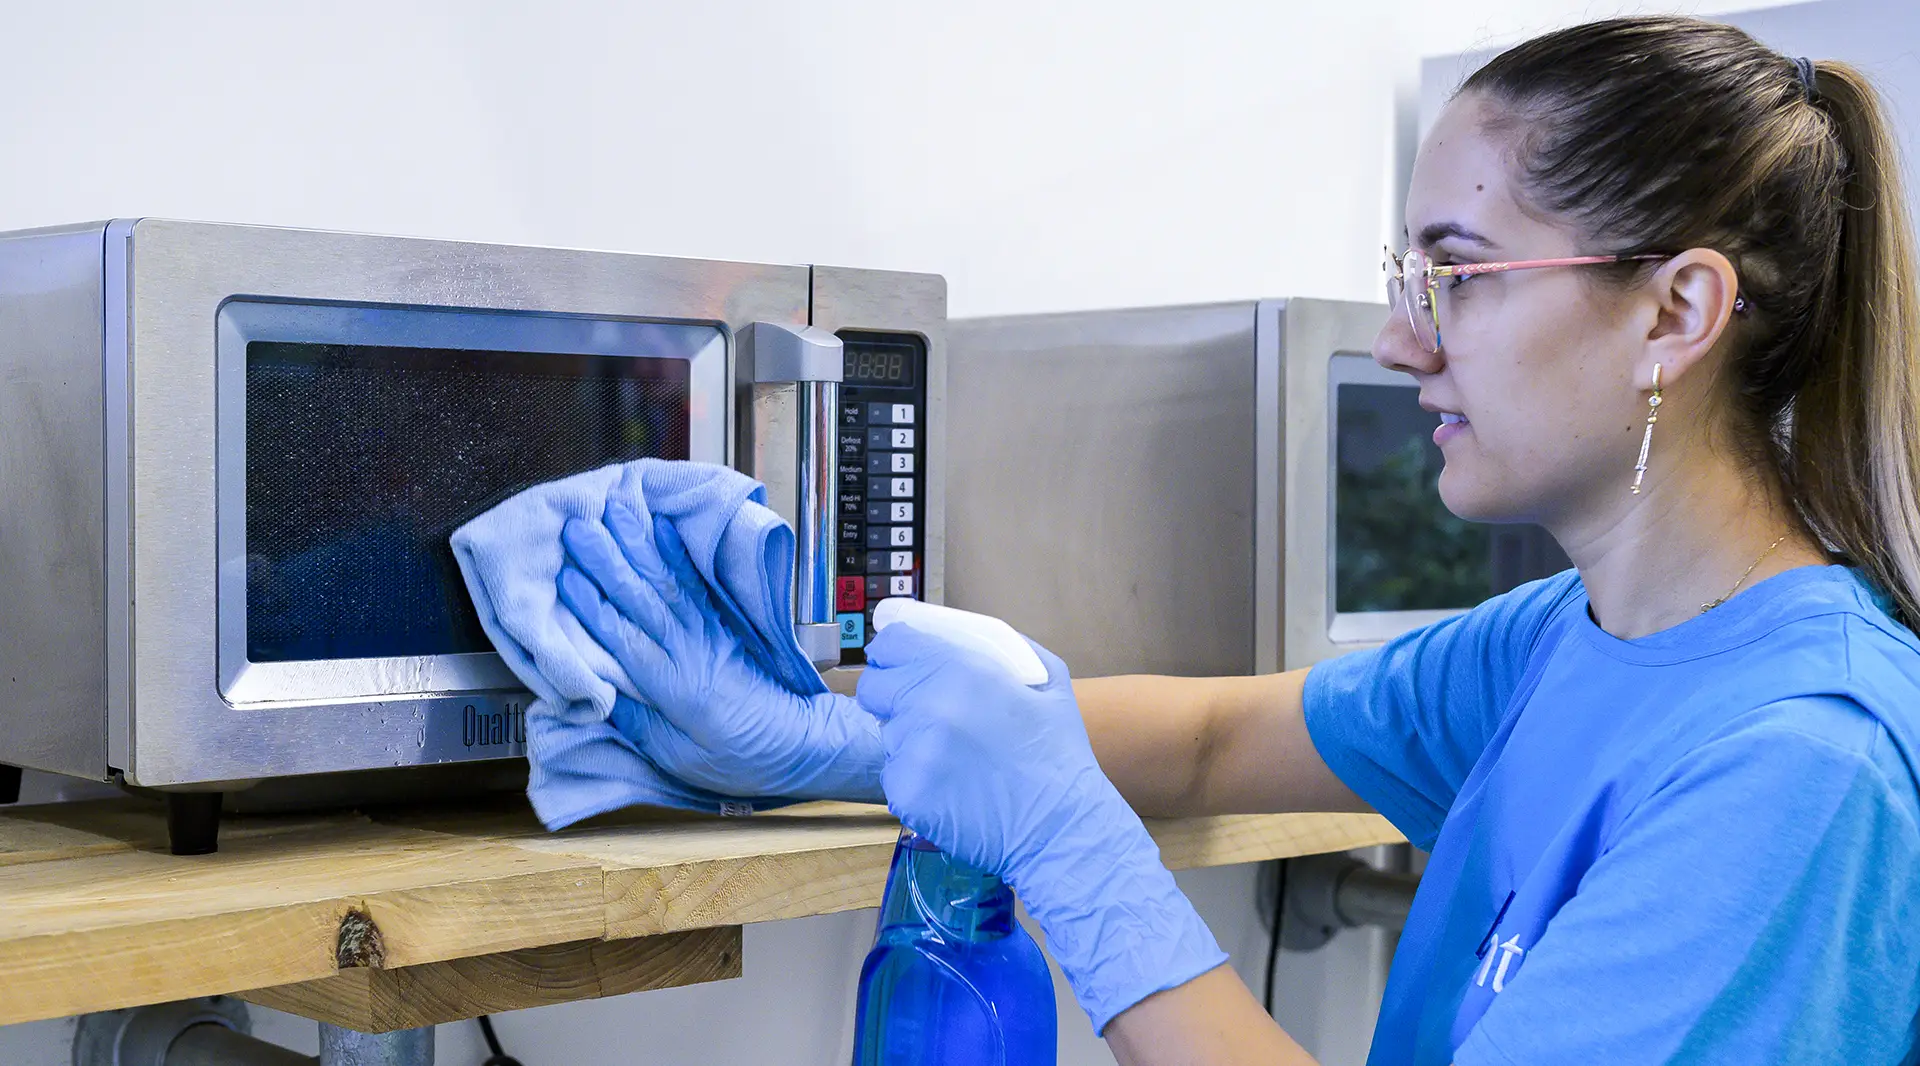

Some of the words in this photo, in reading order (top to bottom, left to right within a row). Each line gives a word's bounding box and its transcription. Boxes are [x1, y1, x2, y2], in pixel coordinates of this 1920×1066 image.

[844, 407, 859, 416] Hold
[901, 408, 906, 419] 1
[846, 416, 856, 424] 0%
[840, 436, 862, 445] Defrost
[900, 432, 906, 444] 2
[844, 444, 858, 453] 20%
[899, 457, 906, 469] 3
[839, 465, 863, 474] Medium
[844, 474, 858, 482] 50%
[898, 482, 906, 493] 4
[844, 503, 858, 511] 70%
[899, 506, 905, 518] 5
[843, 523, 858, 531] Time
[842, 530, 858, 540] Entry
[898, 531, 905, 543] 6
[898, 556, 905, 567] 7
[898, 580, 905, 591] 8
[841, 632, 859, 641] Start
